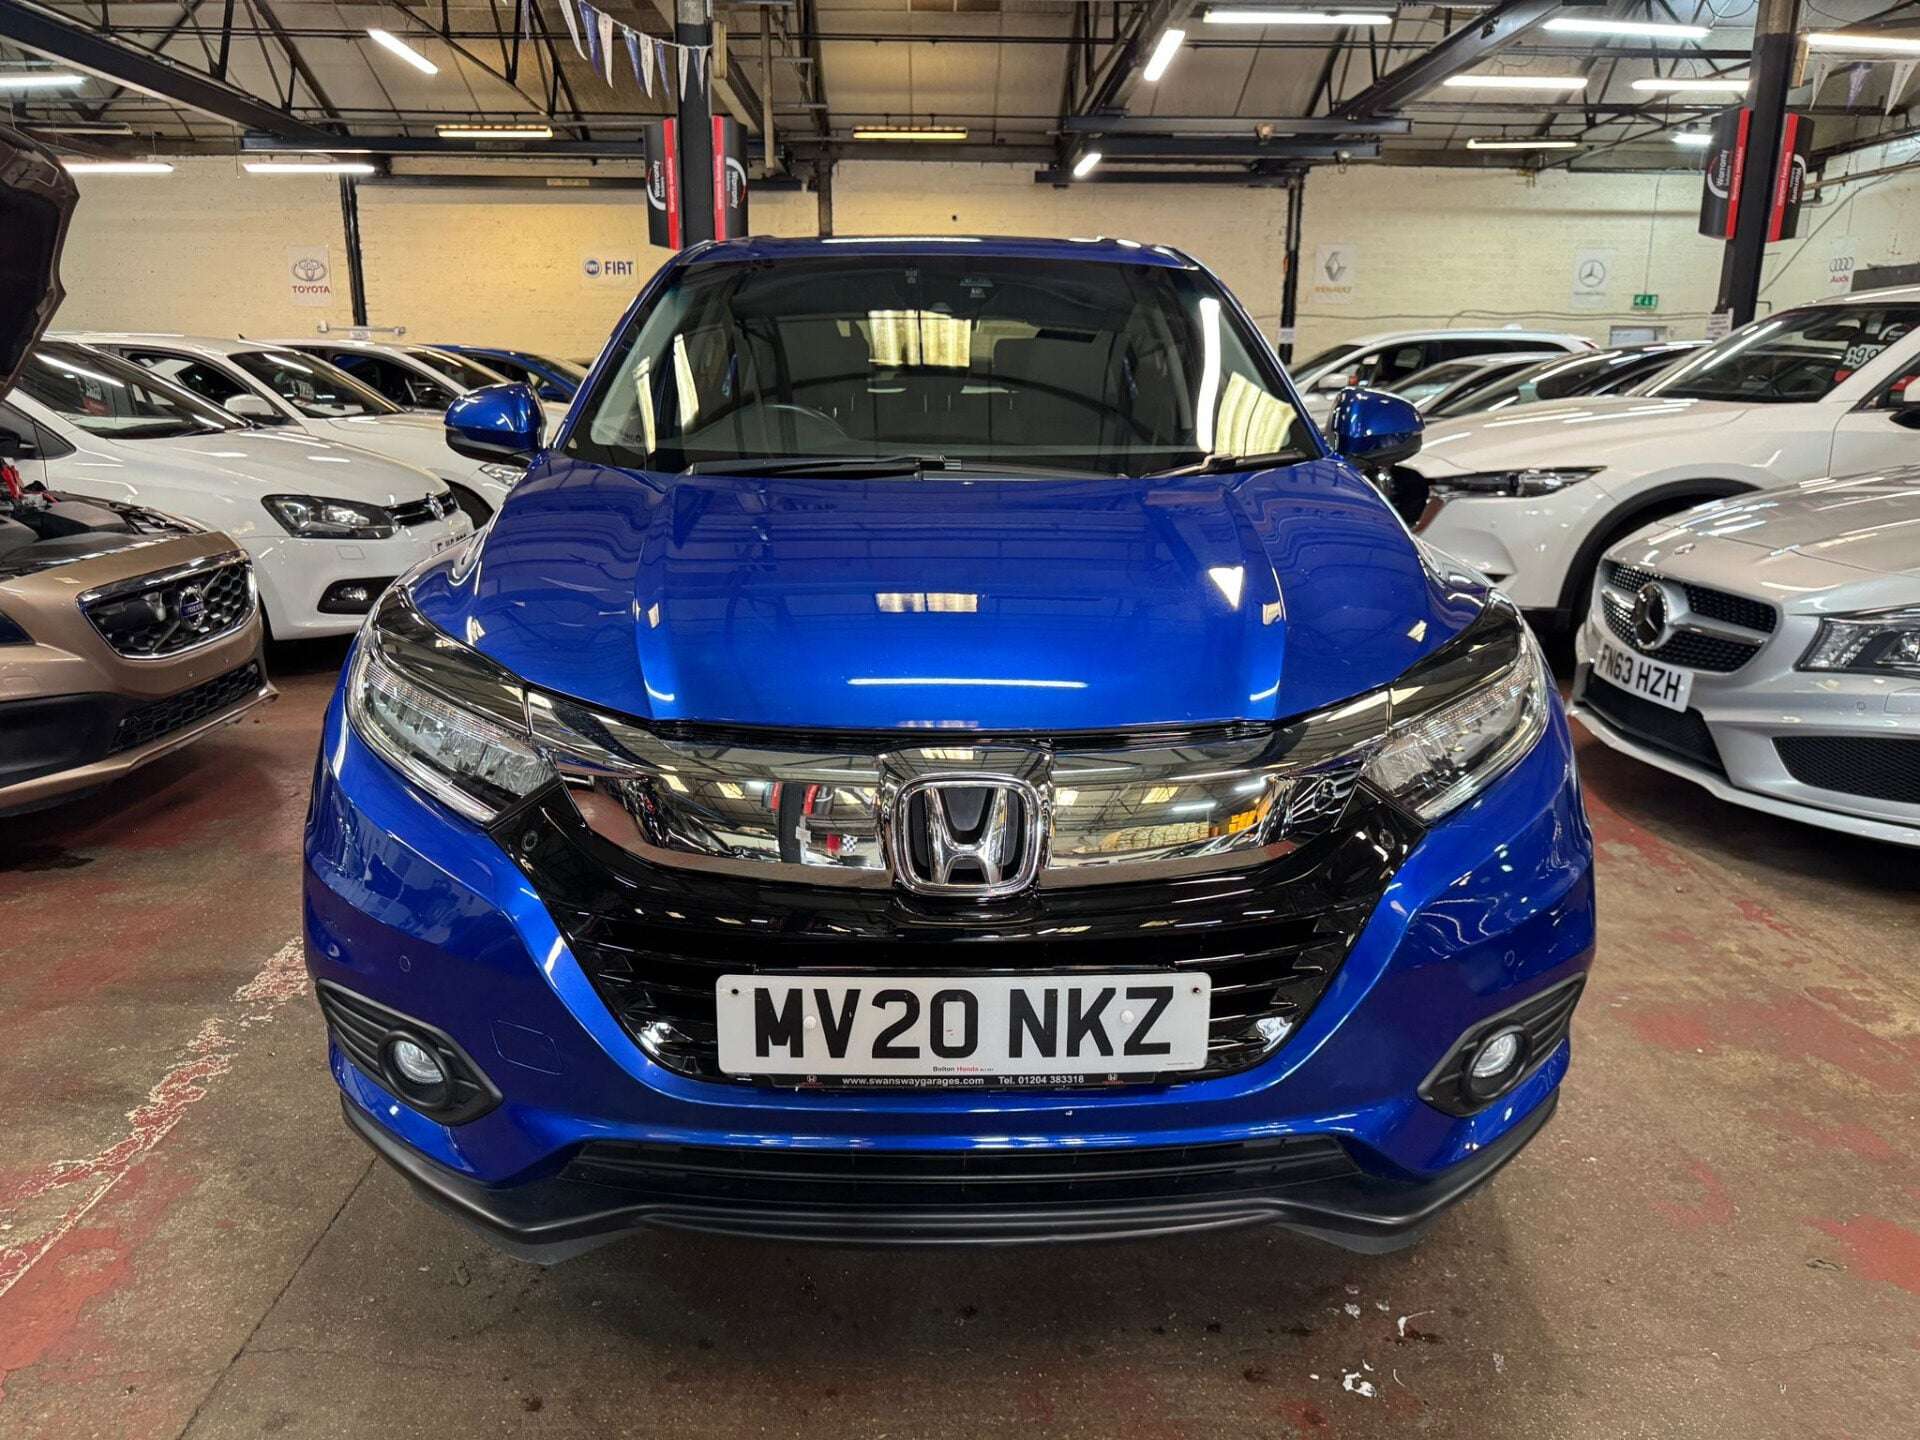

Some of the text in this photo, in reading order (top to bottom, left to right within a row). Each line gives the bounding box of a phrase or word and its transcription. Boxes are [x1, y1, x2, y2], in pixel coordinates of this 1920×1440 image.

[604, 260, 634, 275] FIAT
[292, 285, 331, 294] TOYOTA
[1599, 644, 1681, 702] FN63 HZH
[754, 986, 1174, 1059] MV20 NKZ
[932, 1065, 955, 1073] Bolton
[842, 1074, 1085, 1087] www.swanswaygarages.com Tel. 01204 383318
